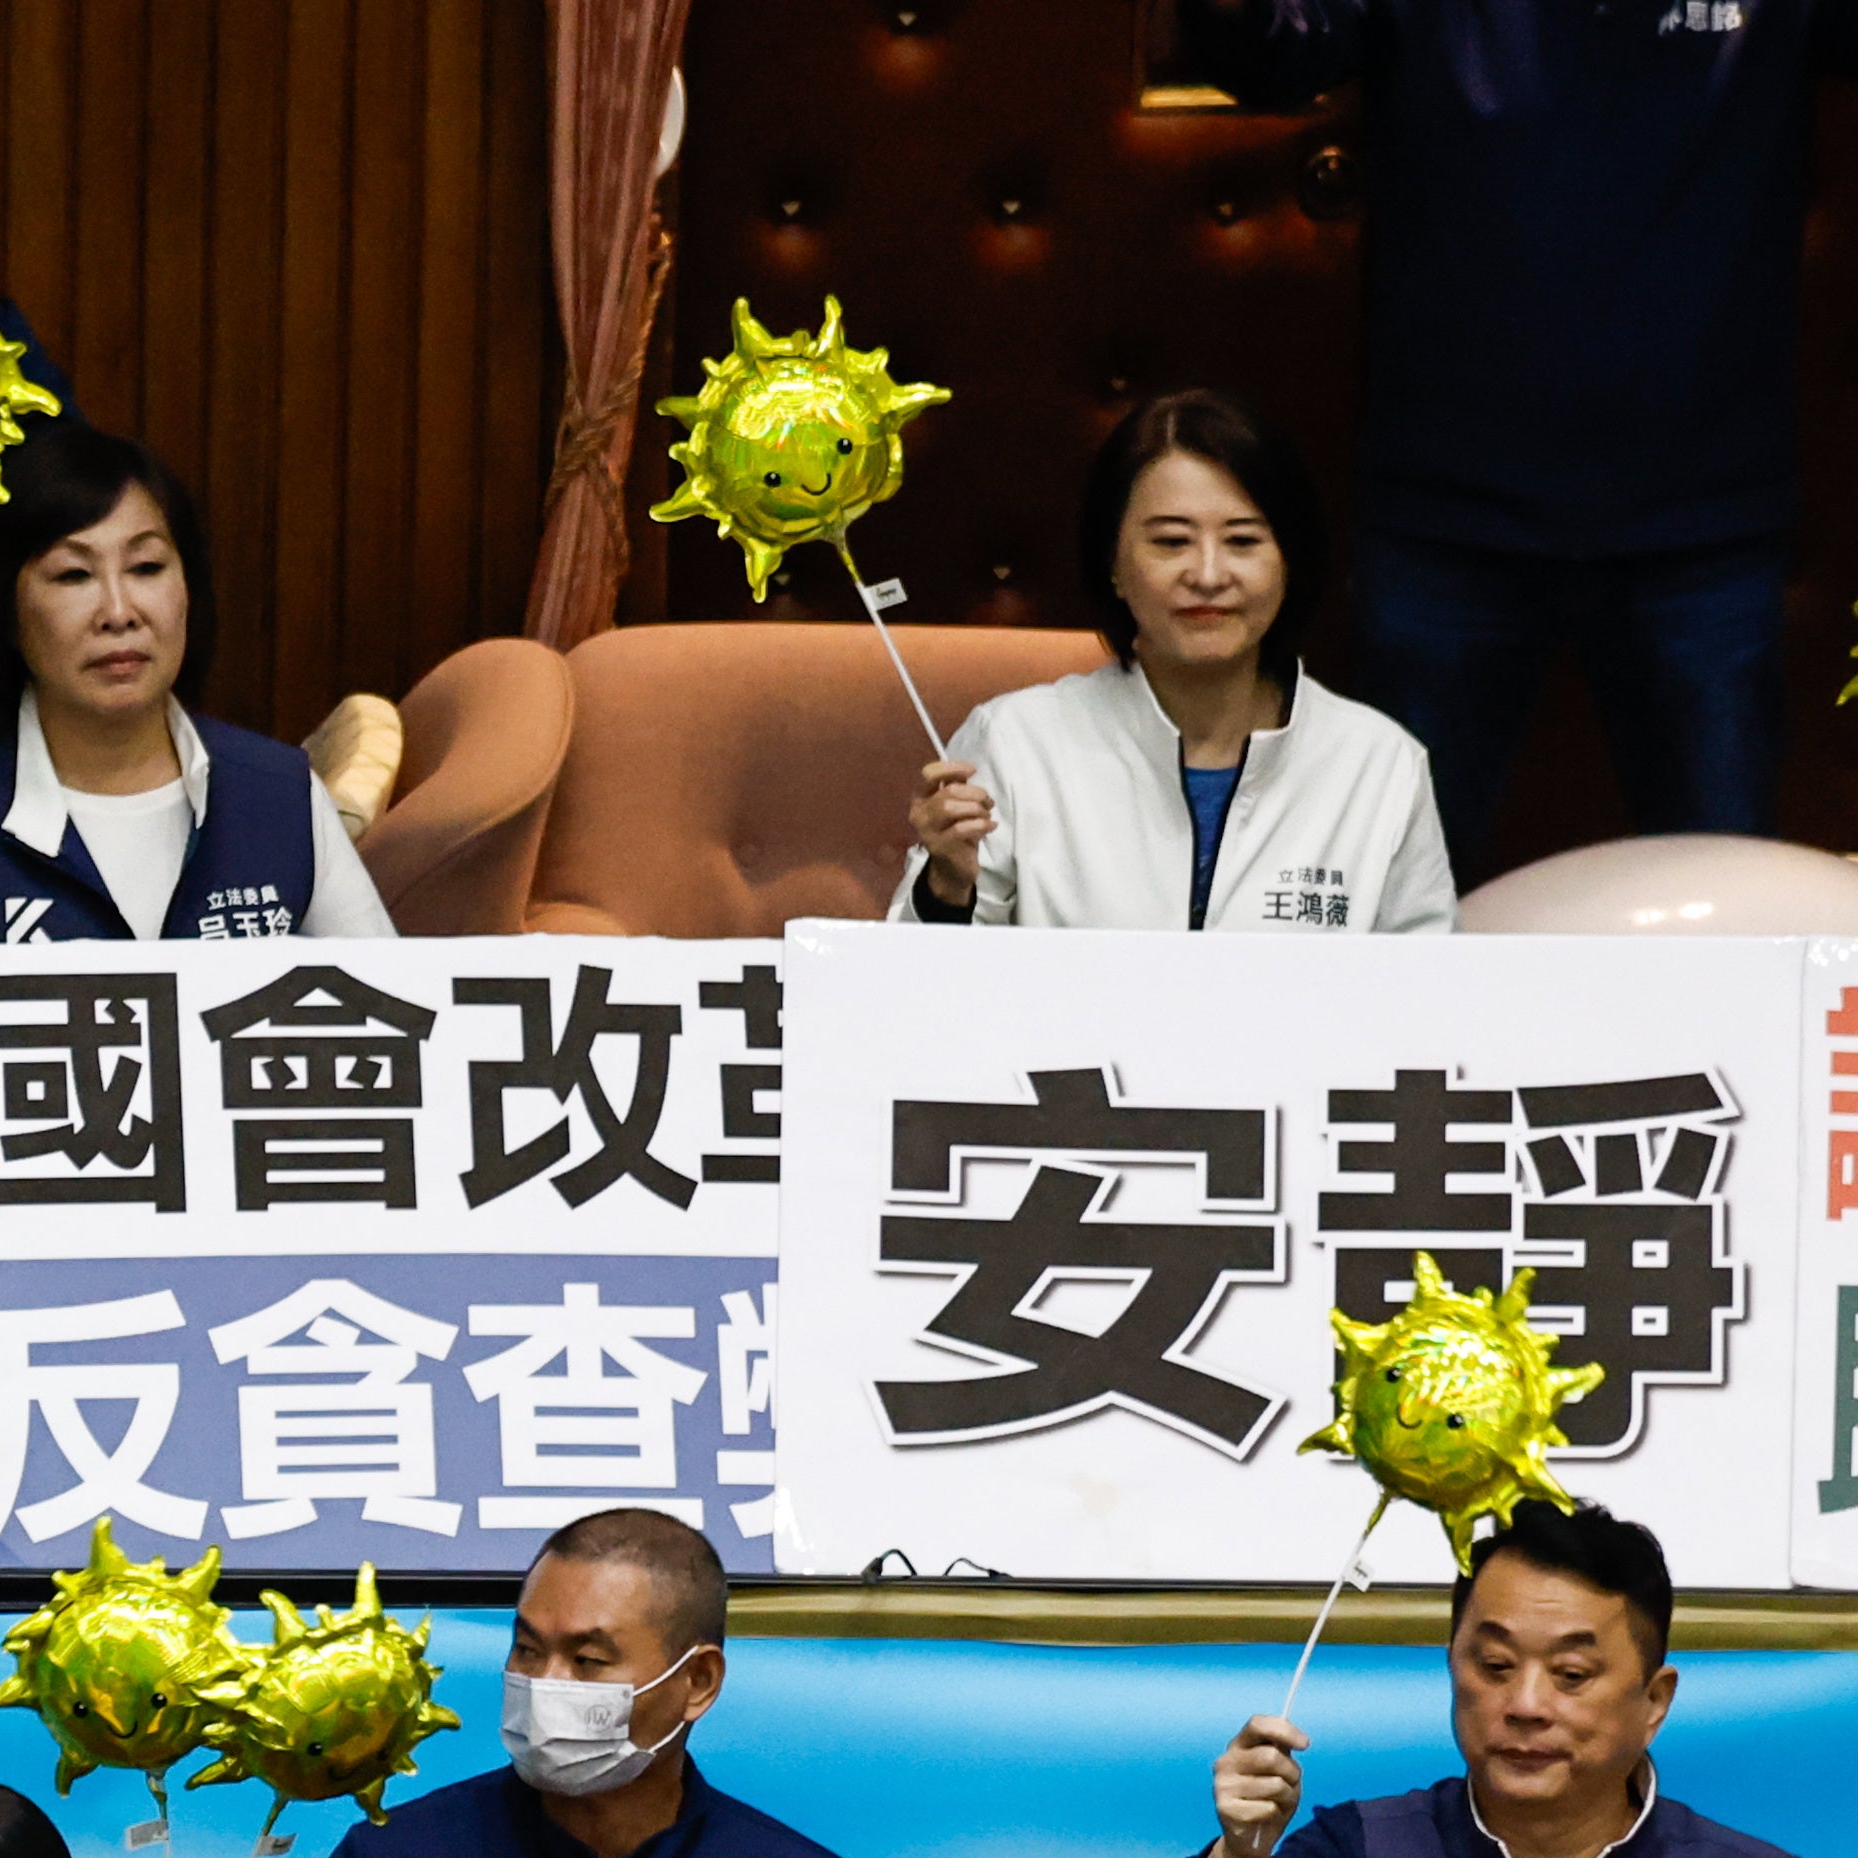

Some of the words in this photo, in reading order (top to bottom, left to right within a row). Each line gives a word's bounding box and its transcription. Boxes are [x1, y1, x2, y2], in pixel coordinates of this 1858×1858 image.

[1277, 866, 1343, 887] 立法委員
[207, 885, 279, 910] 立法委員
[1262, 891, 1349, 927] 王鴻薇
[873, 1065, 1745, 1460] 安靜
